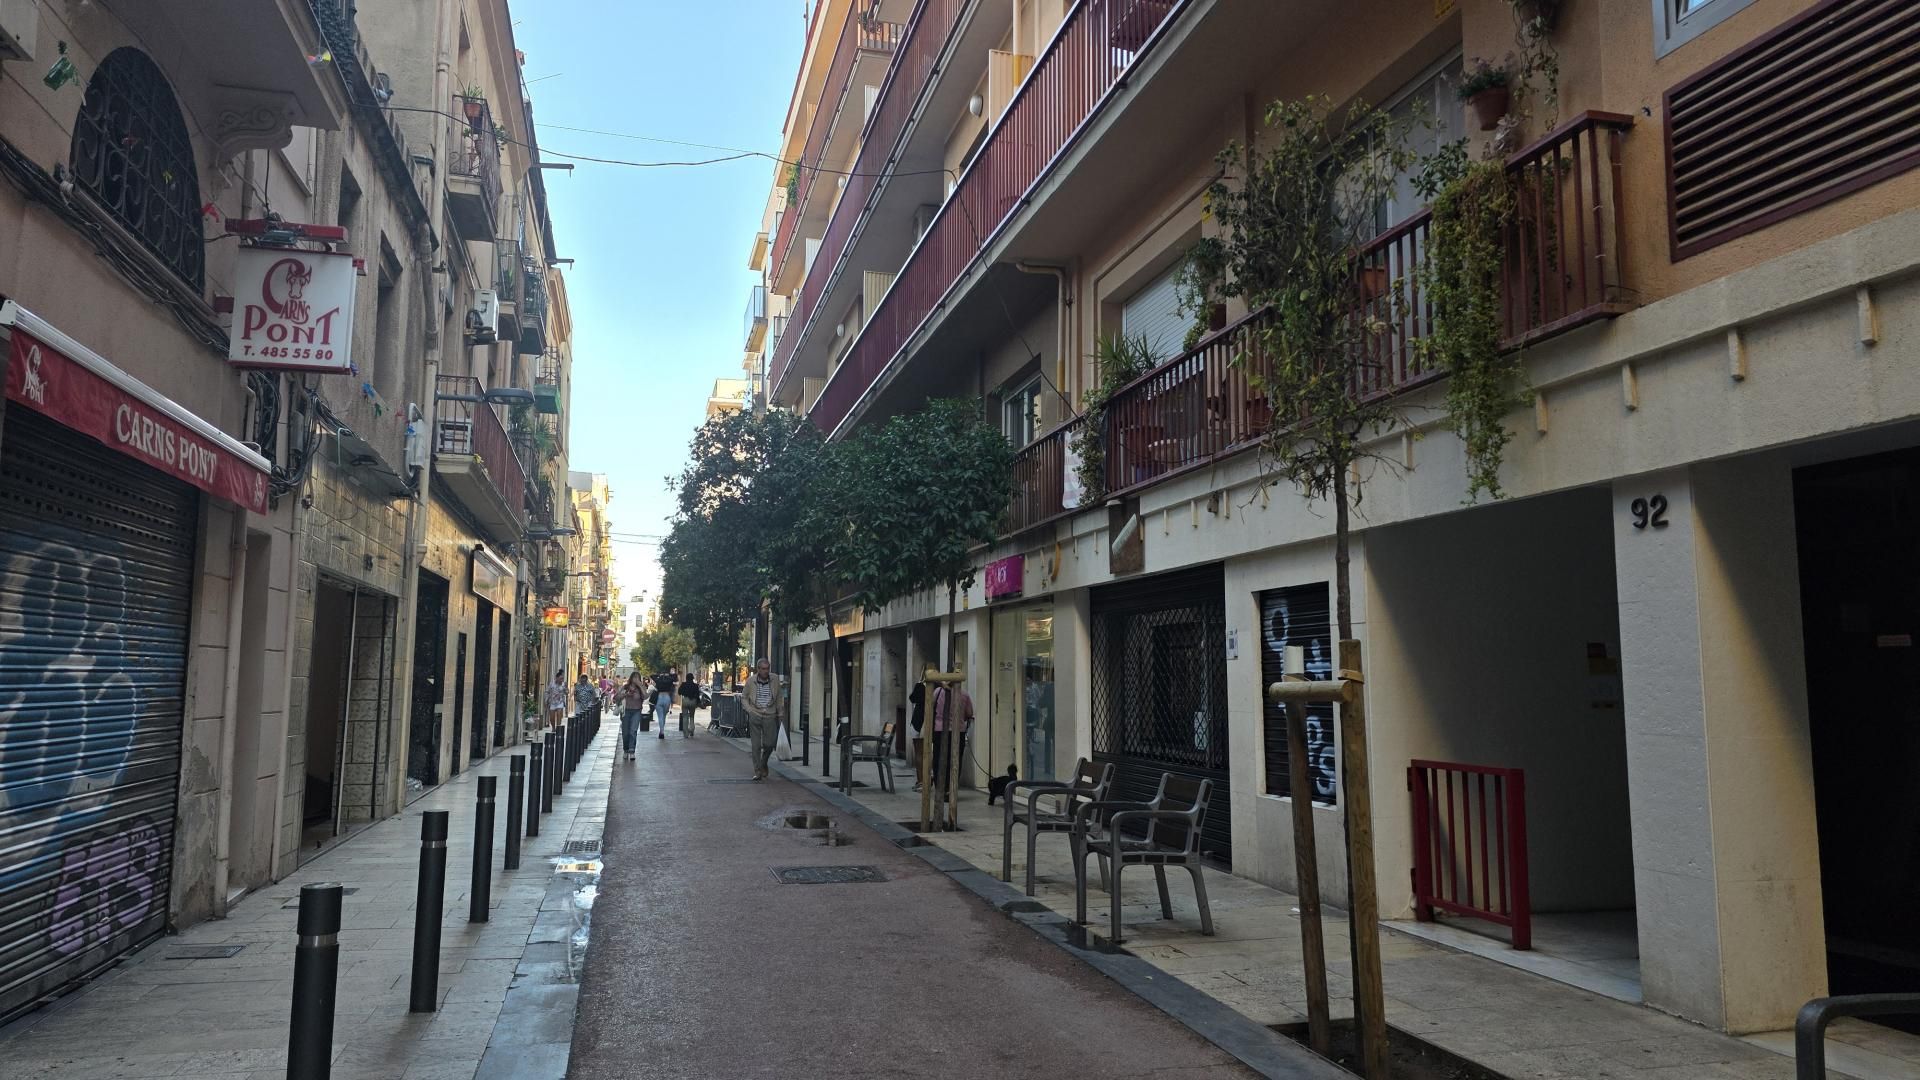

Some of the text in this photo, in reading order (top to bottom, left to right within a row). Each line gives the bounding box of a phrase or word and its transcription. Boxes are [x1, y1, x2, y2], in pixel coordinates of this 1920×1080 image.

[241, 305, 339, 345] PONT
[244, 346, 333, 360] T. 485 55 80
[117, 404, 217, 483] CARNS PONT
[1631, 495, 1669, 529] 92
